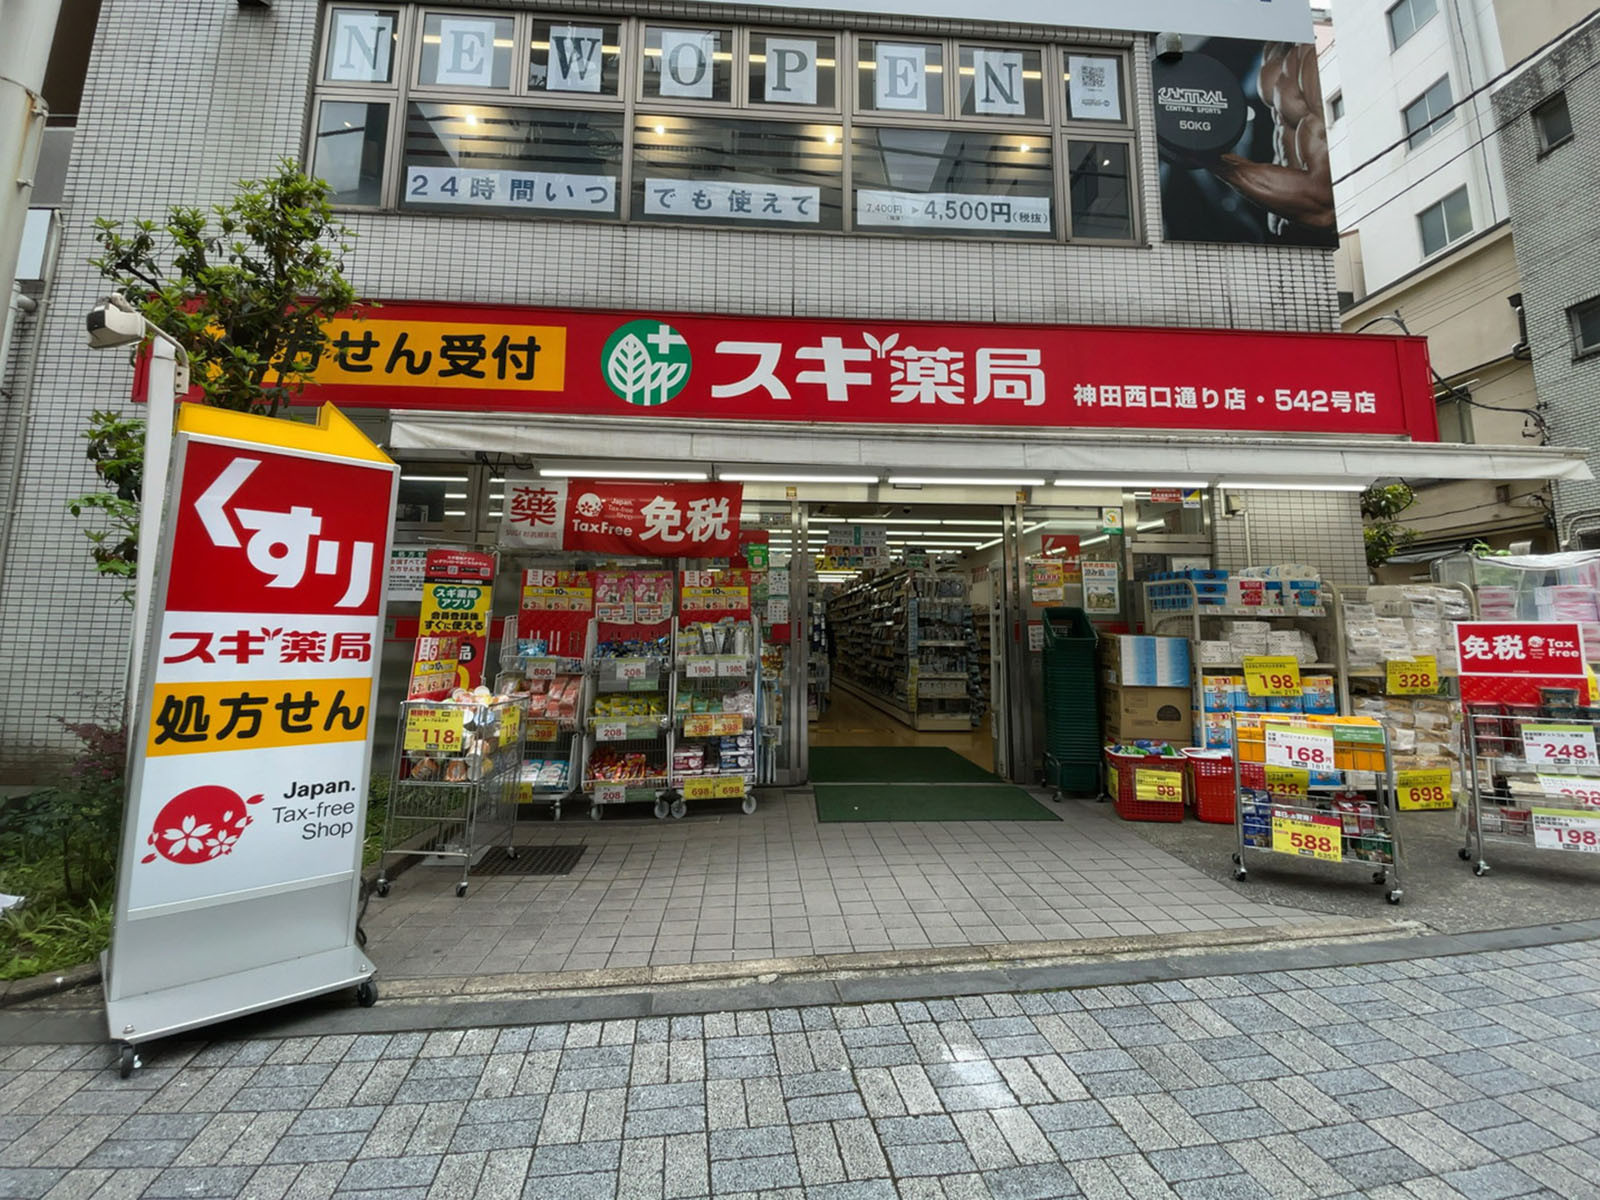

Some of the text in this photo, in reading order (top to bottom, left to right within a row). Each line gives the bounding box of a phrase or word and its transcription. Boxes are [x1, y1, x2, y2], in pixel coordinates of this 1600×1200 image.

[339, 22, 1019, 105] NEW OPEN
[1165, 104, 1194, 113] CENTRAL
[1179, 120, 1211, 131] 50KG
[411, 171, 814, 216] 24時間いつ でも使えて
[711, 331, 1045, 406] スギ薬局
[572, 519, 633, 537] Tax Free
[639, 495, 731, 544] 免税
[194, 457, 374, 608] くすり
[436, 588, 478, 599] スギ薬局
[440, 599, 471, 608] アプリ
[424, 620, 484, 631] すぐに使える
[163, 627, 372, 664] スギ薬局
[1461, 635, 1527, 660] 免税
[1547, 638, 1574, 648] Tax
[1548, 648, 1580, 658] Free
[155, 690, 365, 745] 処方せん
[284, 780, 356, 800] Japan.
[272, 800, 355, 824] Tax-free
[302, 821, 354, 840] Shop
